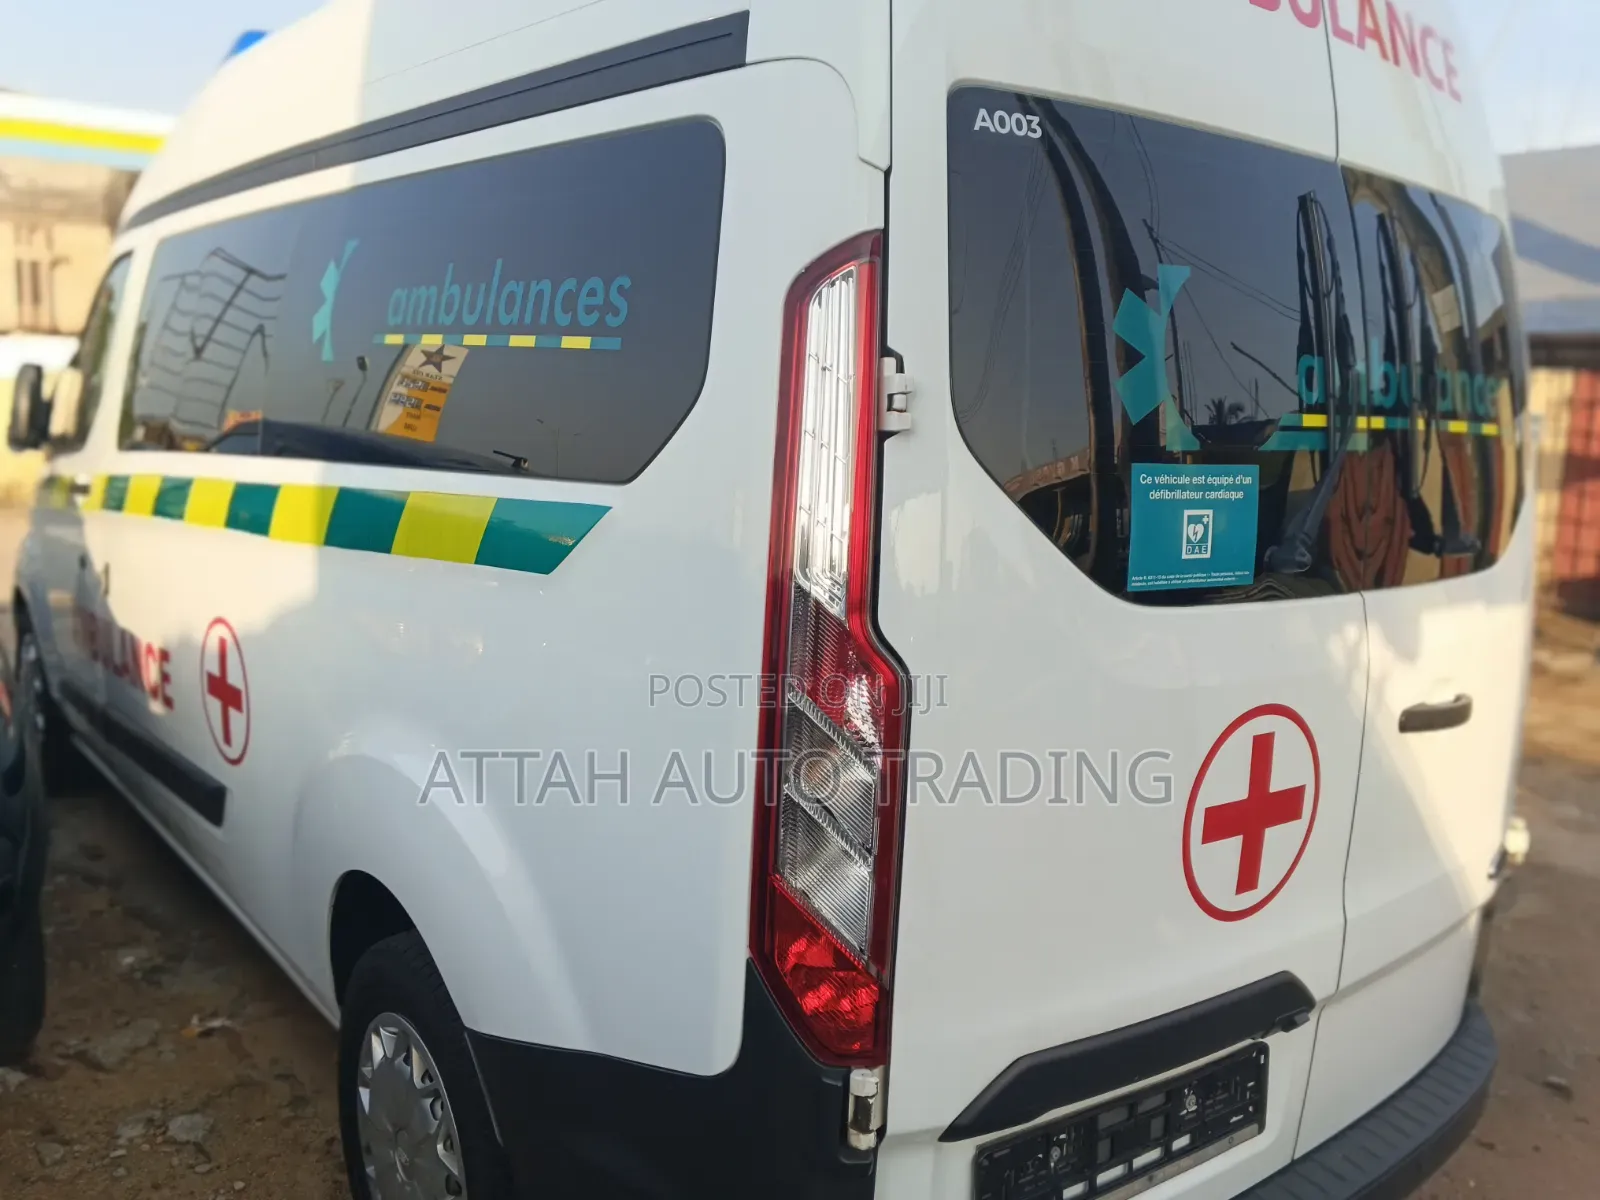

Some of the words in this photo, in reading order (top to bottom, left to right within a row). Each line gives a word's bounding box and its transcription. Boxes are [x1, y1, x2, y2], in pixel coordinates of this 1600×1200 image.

[973, 107, 1042, 139] A003
[387, 258, 632, 328] ambulances
[1140, 474, 1152, 485] Ce
[1154, 474, 1190, 485] véhicule
[1192, 476, 1205, 485] est
[1207, 475, 1234, 486] équipé
[1235, 475, 1252, 485] d'un
[1149, 489, 1202, 500] défibrillateur
[1205, 489, 1244, 501] cardiaque
